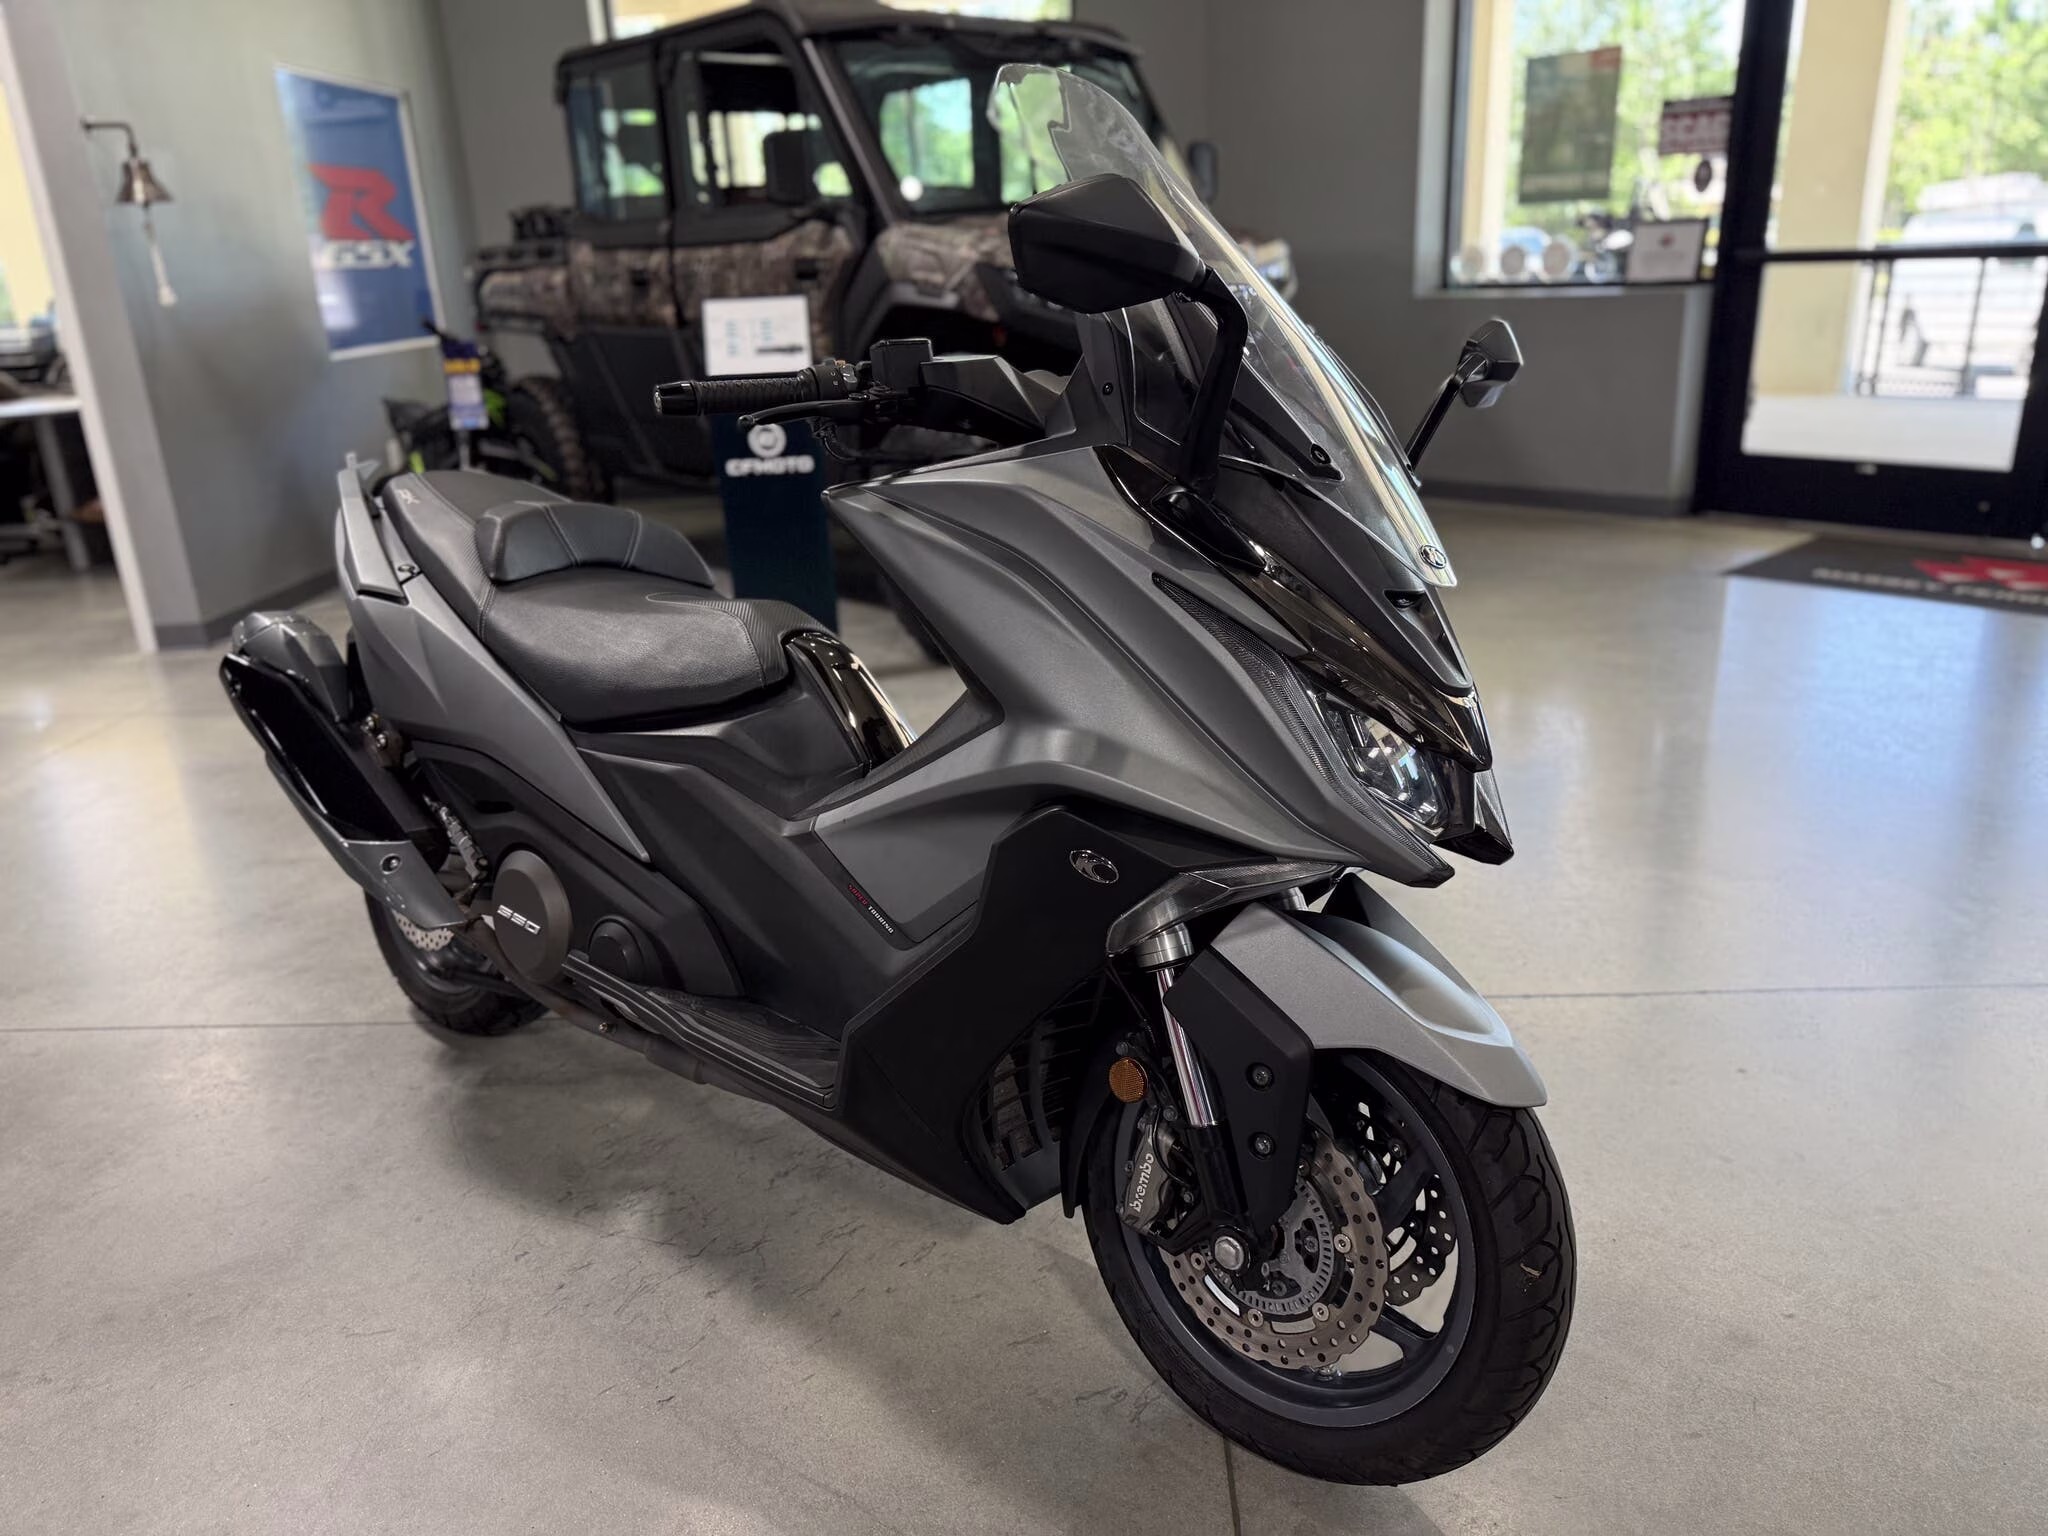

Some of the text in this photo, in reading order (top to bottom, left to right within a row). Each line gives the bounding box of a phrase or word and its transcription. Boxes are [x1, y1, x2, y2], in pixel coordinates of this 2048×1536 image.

[304, 162, 416, 242] R
[319, 241, 413, 269] GSX
[725, 454, 815, 477] CFMOTO
[497, 904, 541, 935] 550
[868, 905, 894, 934] TOURING
[1129, 1153, 1154, 1213] brembo
